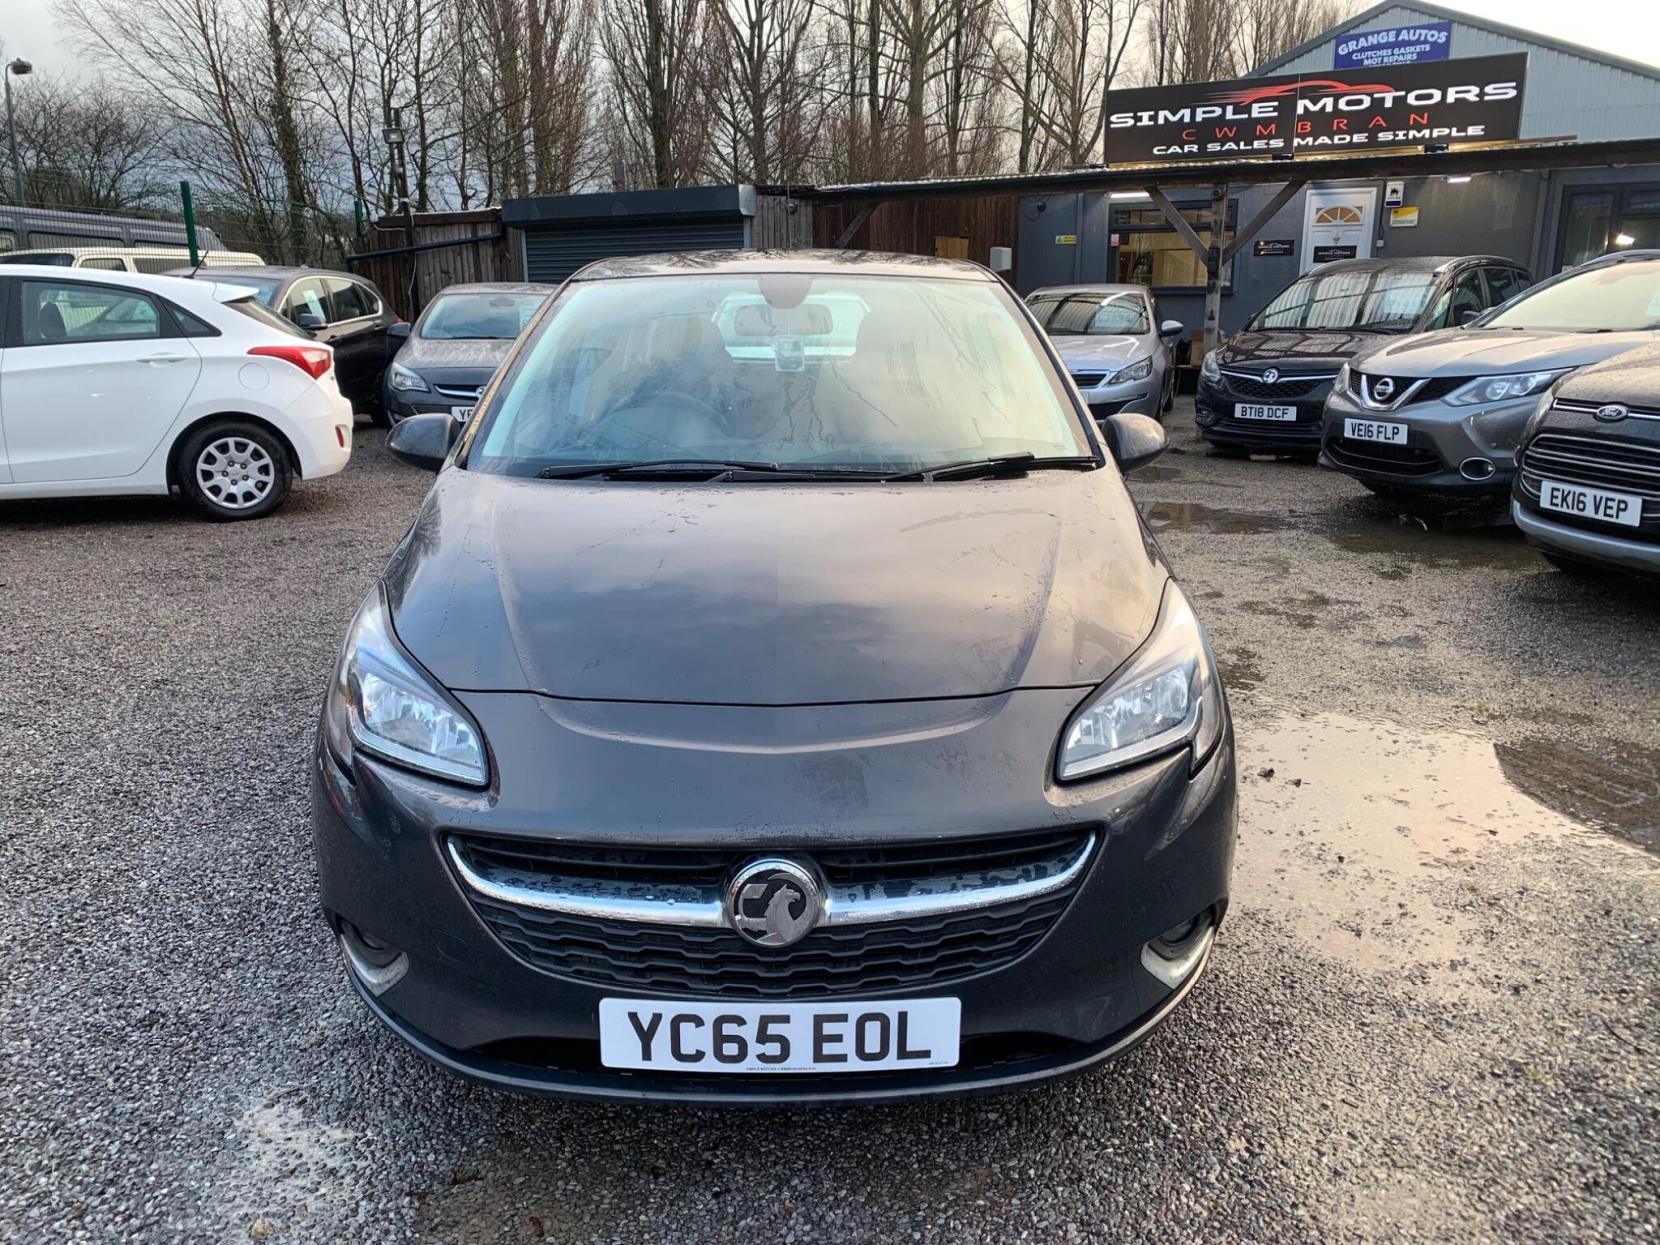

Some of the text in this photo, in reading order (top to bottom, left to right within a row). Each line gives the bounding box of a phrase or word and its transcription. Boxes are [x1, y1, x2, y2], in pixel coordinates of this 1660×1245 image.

[1338, 28, 1448, 55] GRANGE AUTOS
[1352, 43, 1431, 60] CLUTCHES GASKETS
[1363, 57, 1382, 66] MOT
[1383, 52, 1417, 63] REPAIRS
[1109, 82, 1518, 128] SIMPLE MOTORS
[1153, 125, 1486, 155] CAR SALES MADE SIMPLE
[1182, 112, 1429, 141] CWMBRAN
[1240, 406, 1289, 419] BT18 DCF
[1351, 422, 1400, 441] VE16 FLP
[1549, 487, 1628, 520] EK16 VEP
[627, 1010, 932, 1065] YC65 EOL
